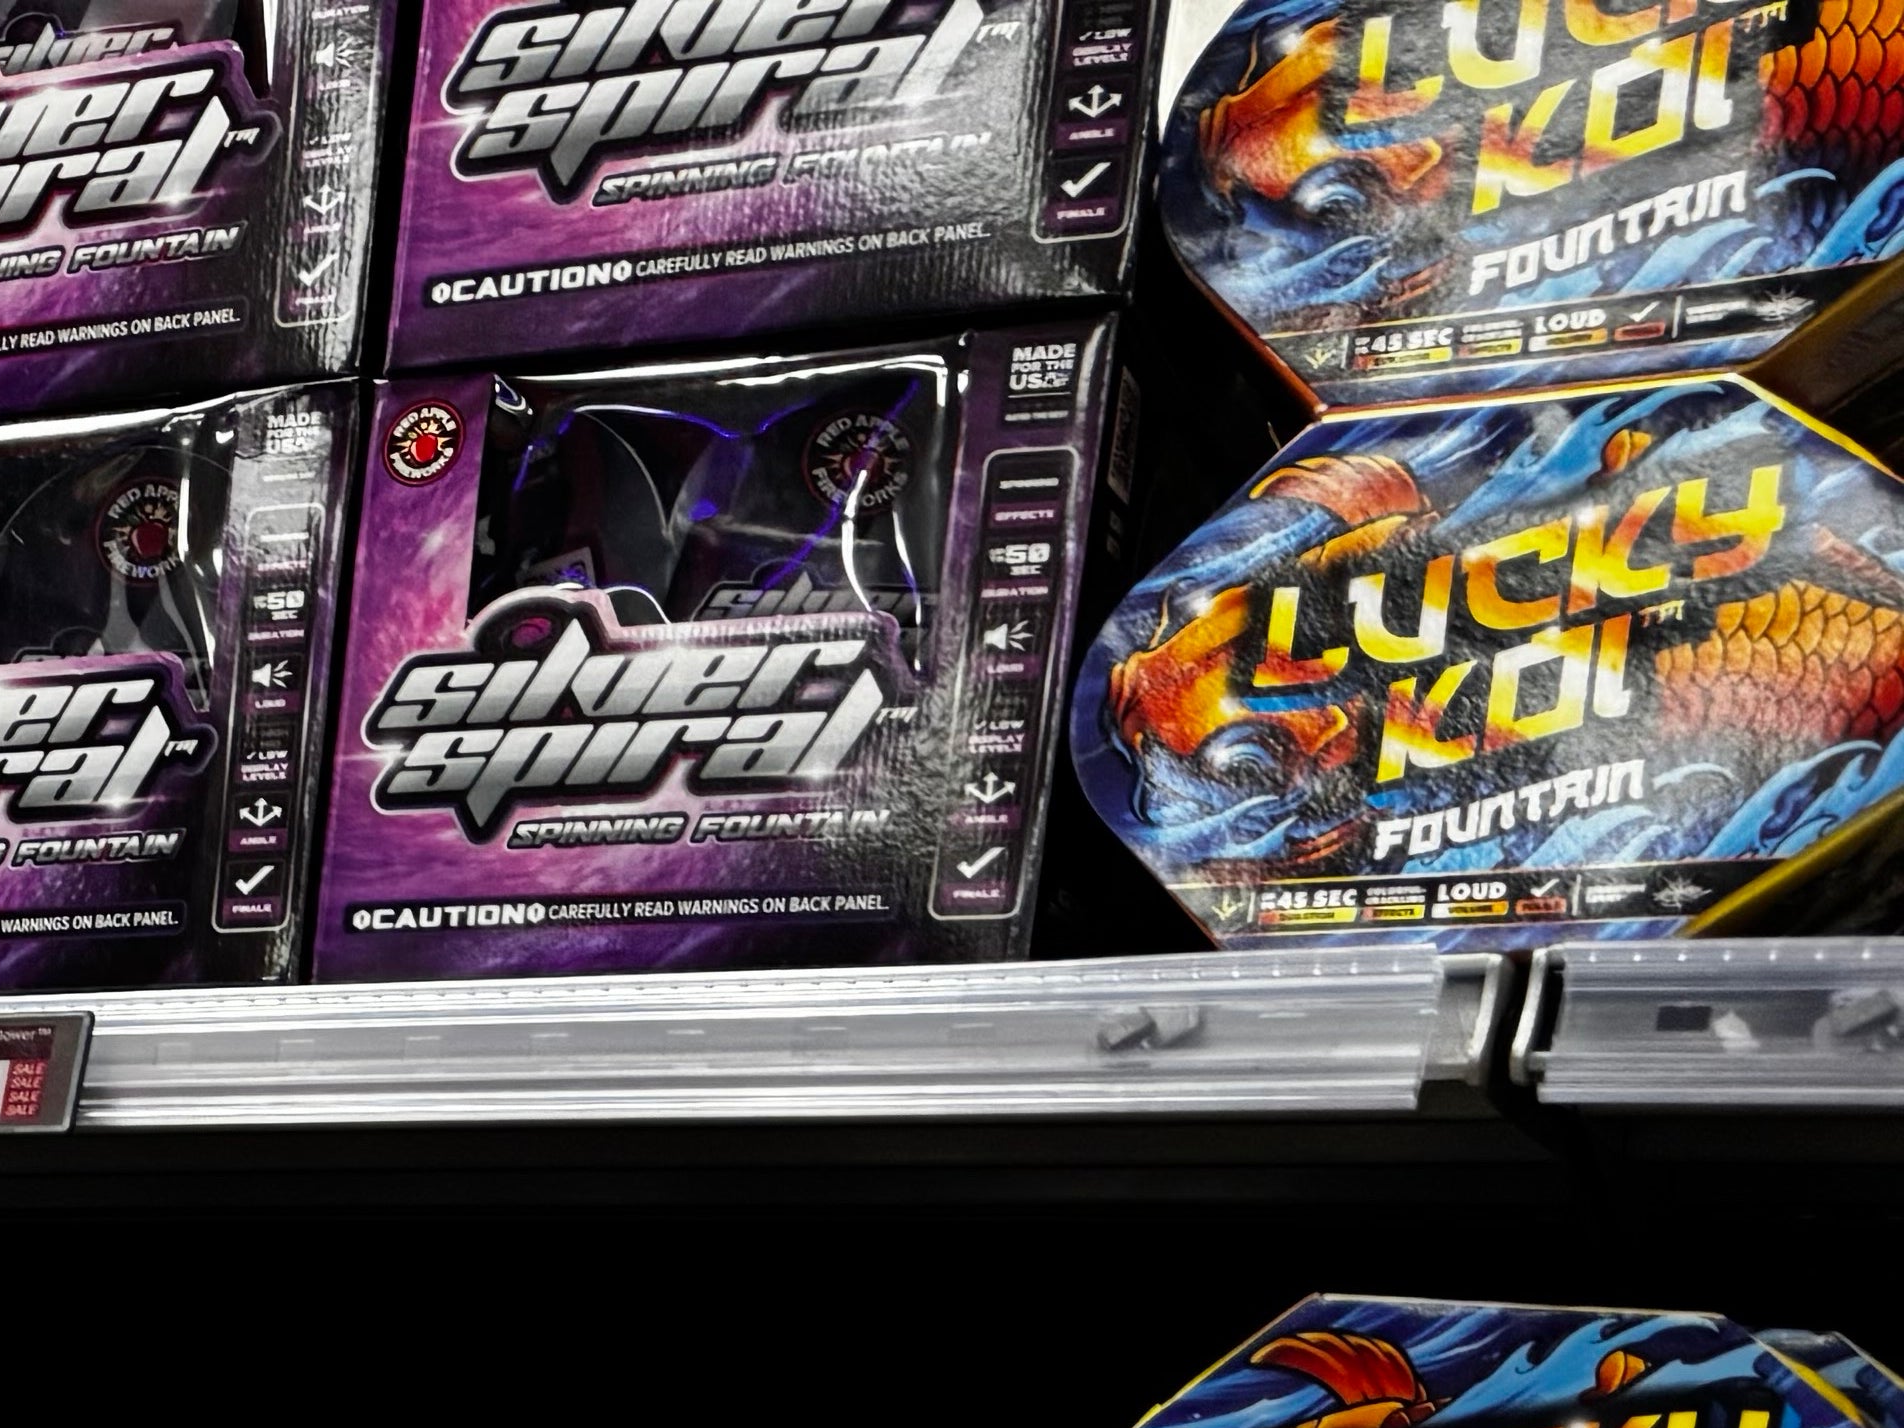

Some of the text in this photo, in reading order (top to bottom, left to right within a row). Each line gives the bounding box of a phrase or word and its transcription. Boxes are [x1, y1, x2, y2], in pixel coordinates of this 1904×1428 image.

[69, 228, 241, 274] FOUNTAIN
[1254, 466, 1784, 689] LUCKY
[1376, 615, 1632, 783] KOI
[1374, 759, 1645, 860] FOUNTAIN
[1278, 889, 1357, 910] 45 SEC
[1437, 880, 1507, 901] LOUD
